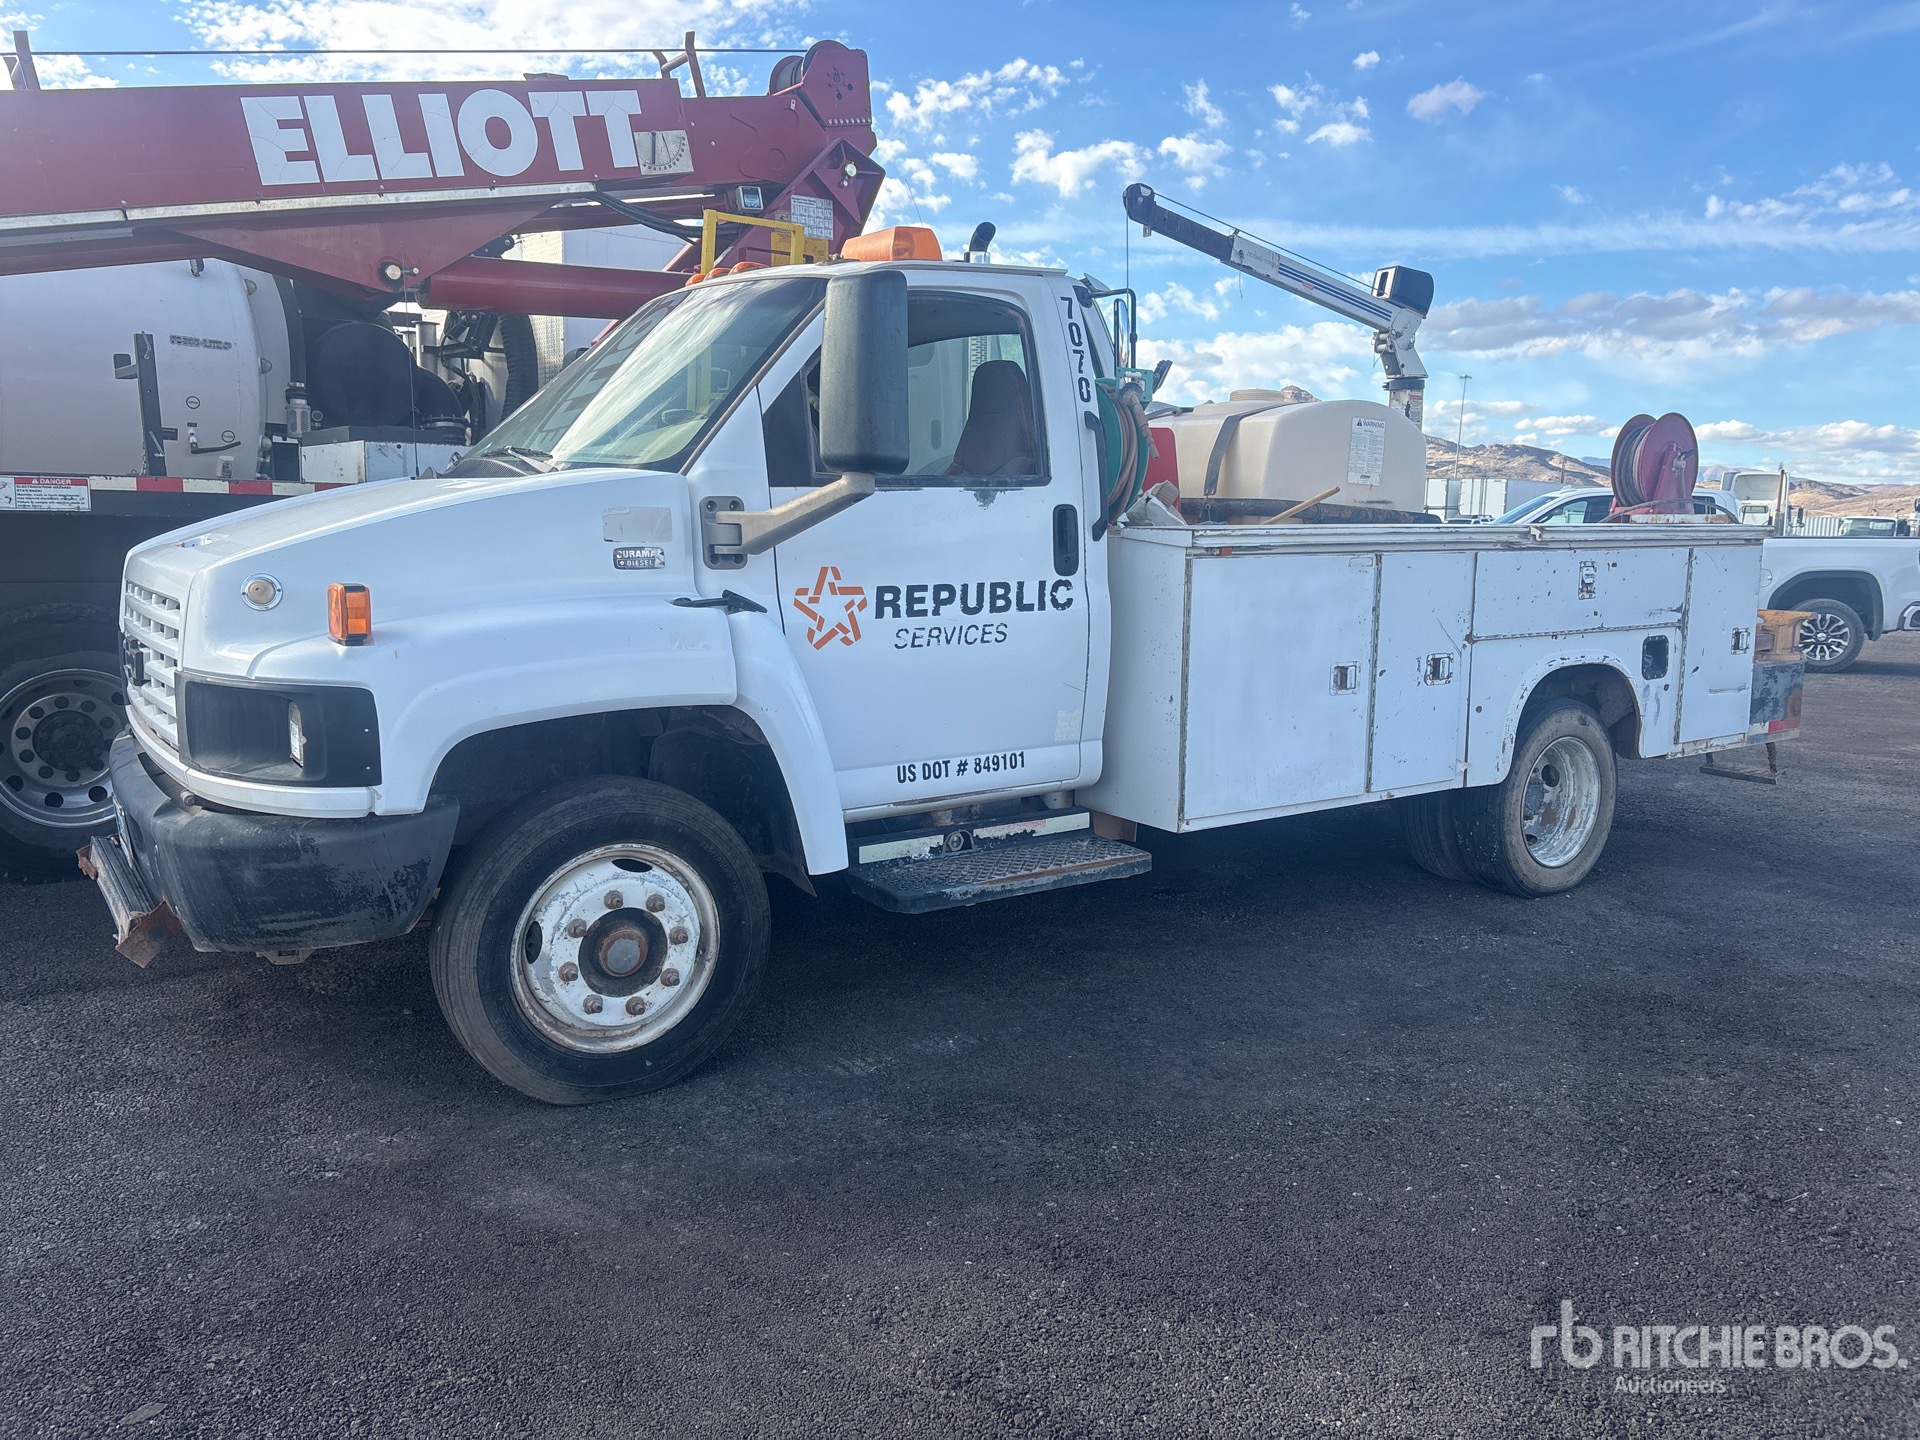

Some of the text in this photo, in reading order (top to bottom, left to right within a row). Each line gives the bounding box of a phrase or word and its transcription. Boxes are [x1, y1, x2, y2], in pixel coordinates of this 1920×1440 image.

[241, 89, 642, 186] ELLIOTT
[1060, 296, 1092, 403] 7070
[1362, 419, 1385, 429] WARNING
[875, 579, 1074, 620] REPUBLIC
[894, 623, 1008, 650] SERVICES
[897, 751, 1025, 783] US DOT # 849101
